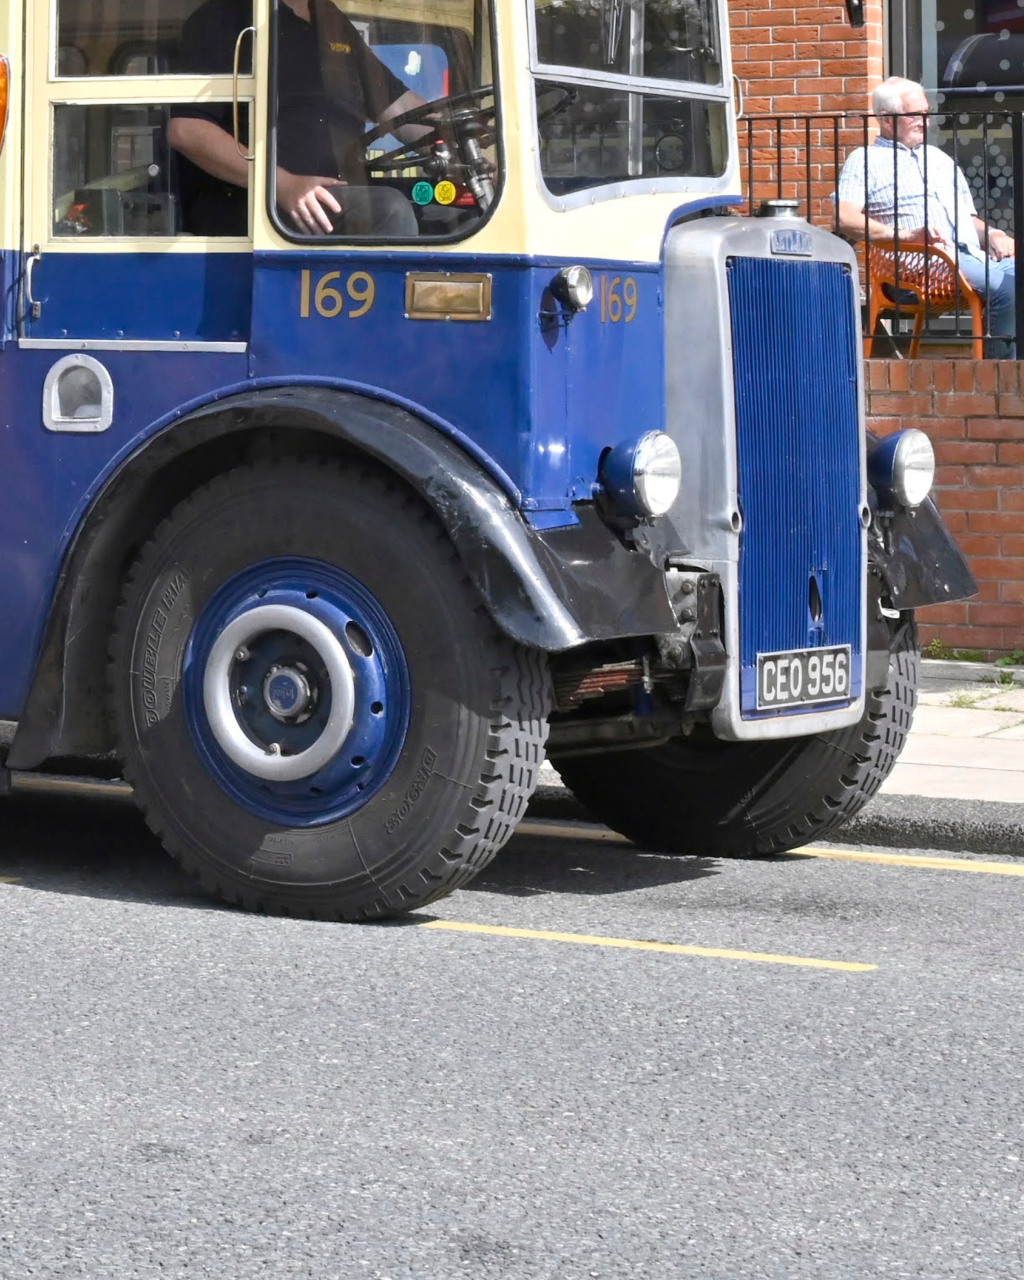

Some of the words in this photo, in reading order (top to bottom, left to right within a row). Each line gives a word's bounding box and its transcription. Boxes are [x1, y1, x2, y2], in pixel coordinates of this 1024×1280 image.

[300, 269, 376, 319] 169
[600, 274, 638, 324] 169
[762, 658, 803, 702] CEO
[807, 652, 847, 696] 956
